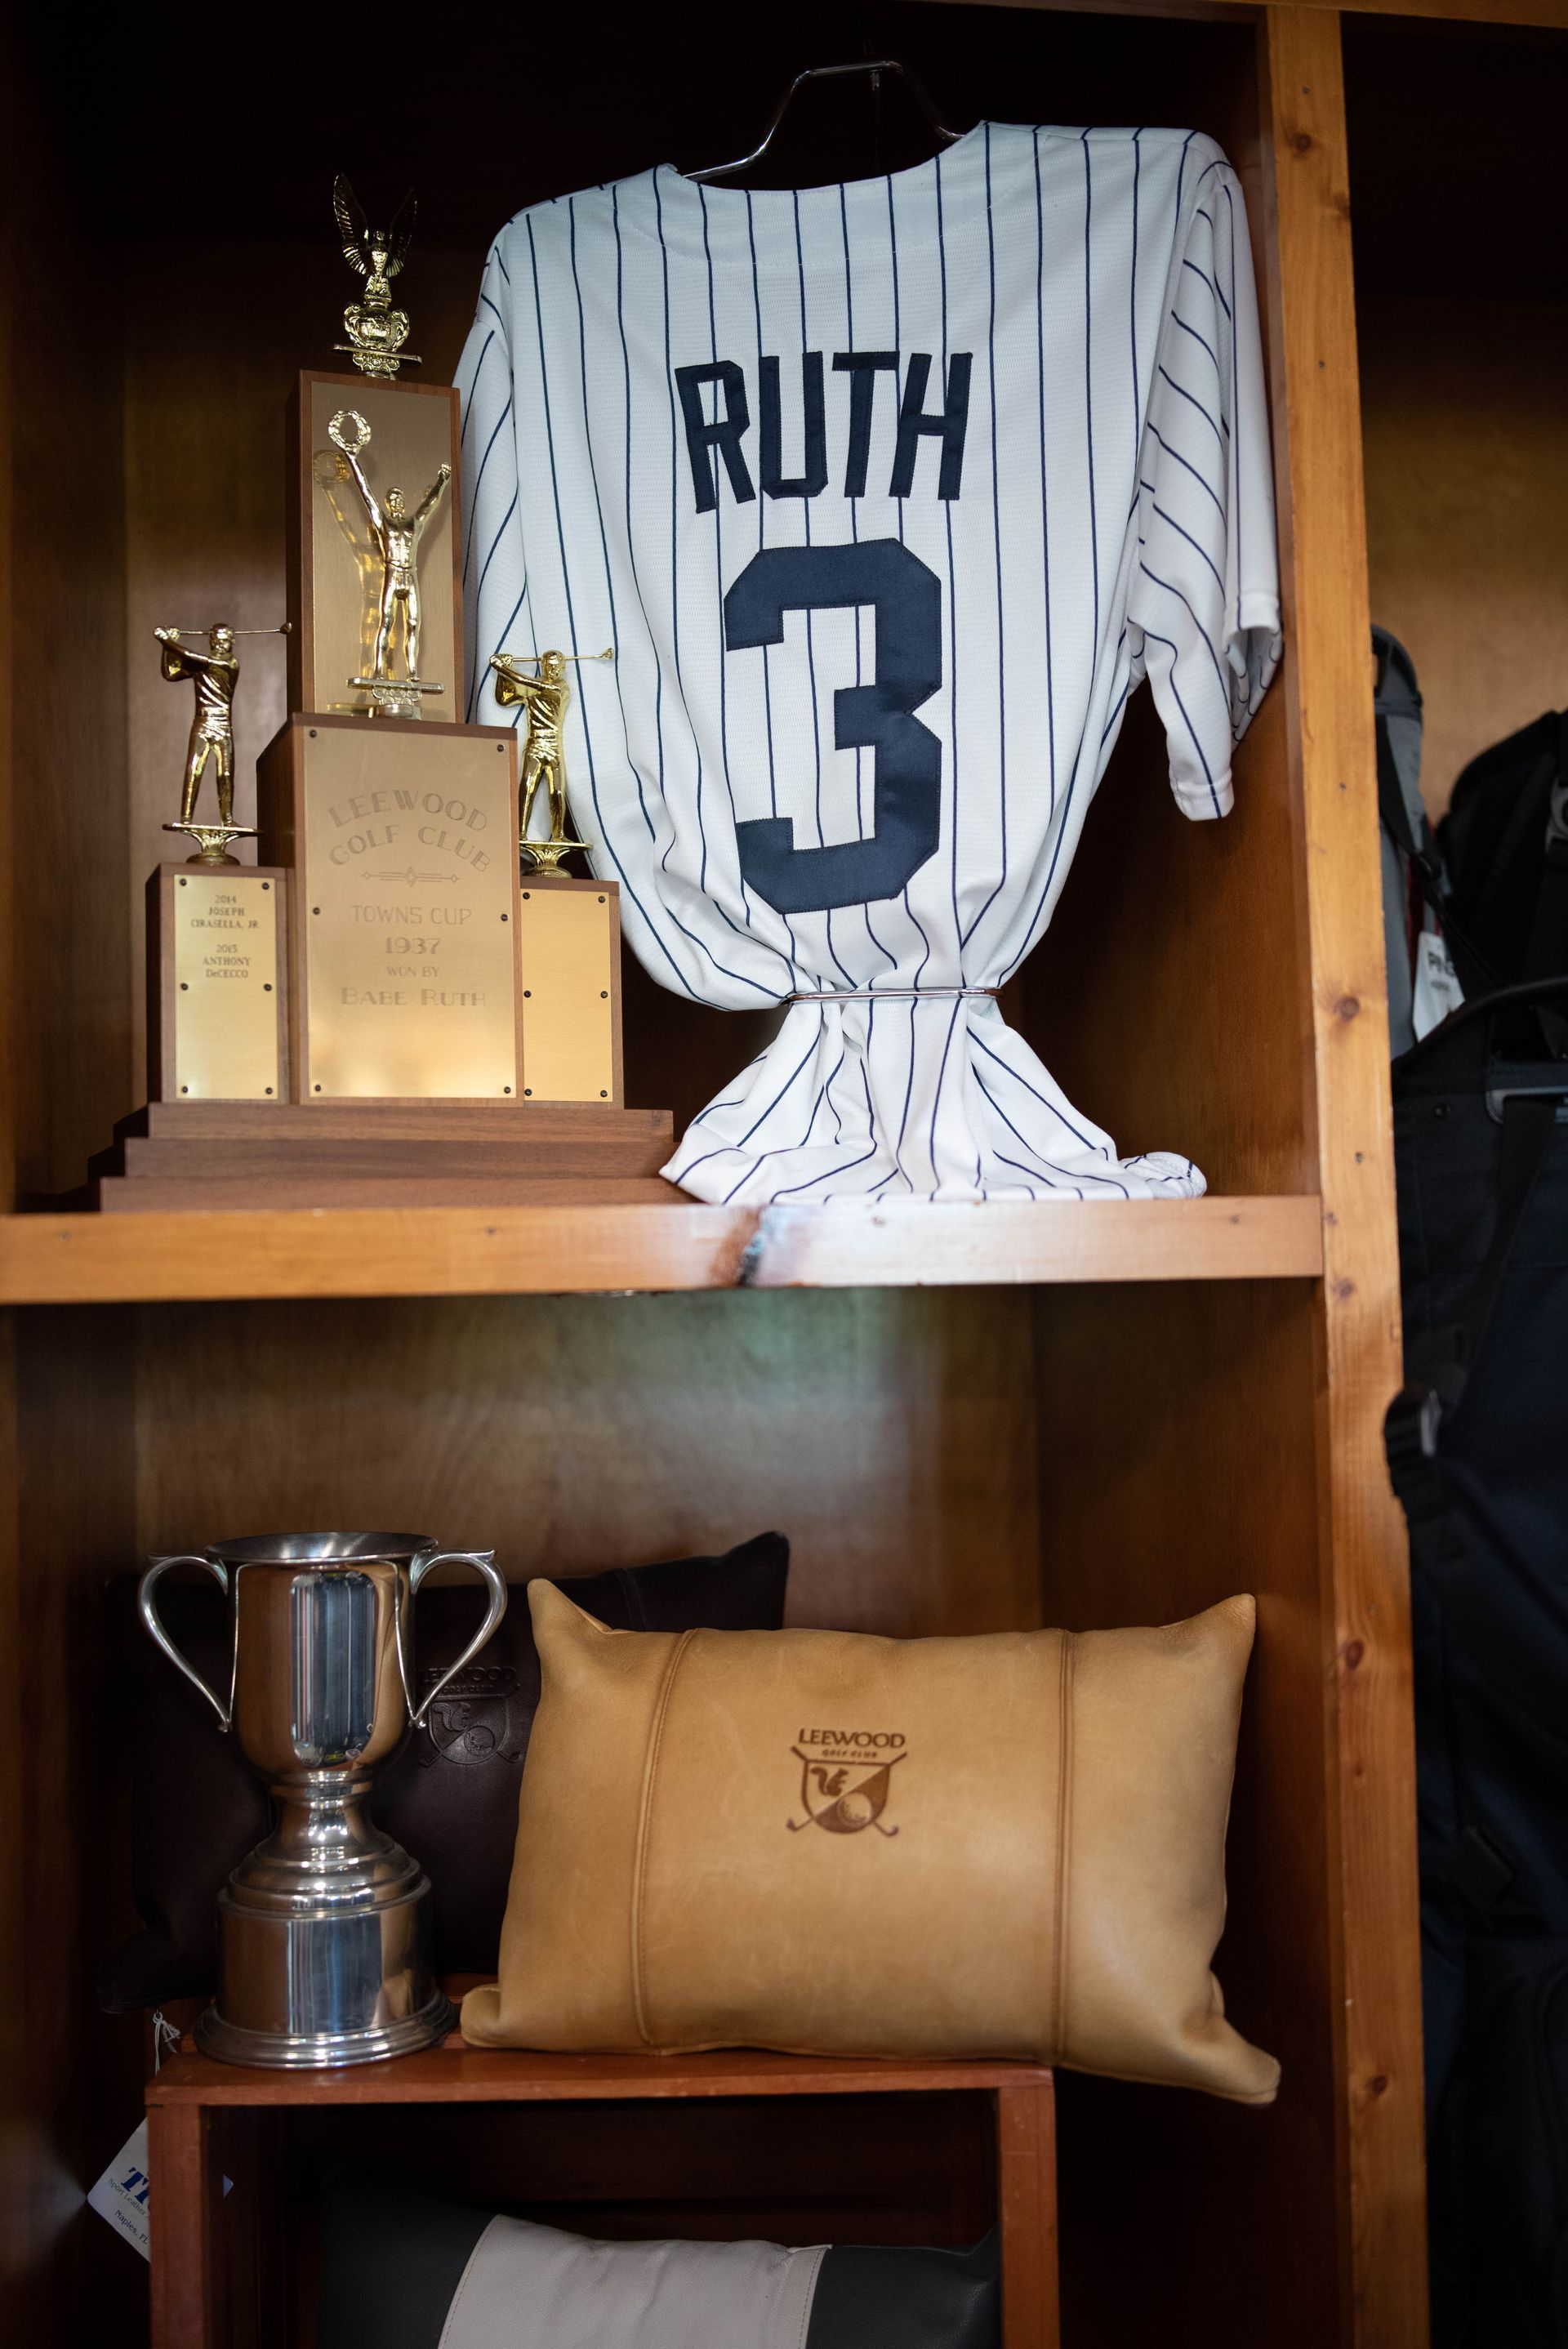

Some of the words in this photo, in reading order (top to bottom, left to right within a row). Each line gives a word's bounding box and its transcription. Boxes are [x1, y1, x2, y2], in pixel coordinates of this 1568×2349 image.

[674, 350, 973, 515] RUTH
[724, 537, 942, 915] 3
[328, 790, 488, 831] LEEWOOD
[329, 824, 400, 866] GOLF
[417, 827, 490, 871] CLUB
[214, 894, 237, 904] 2014
[207, 907, 245, 916] JOSEPH
[351, 905, 422, 925] TOWNS
[430, 907, 472, 925] CUP
[216, 944, 238, 954] 2015
[385, 937, 442, 955] 1937
[202, 956, 252, 966] ANTHONY
[386, 965, 417, 977] WON
[422, 965, 440, 978] BY
[340, 987, 407, 1006] BABE
[421, 988, 487, 1006] RUTH
[798, 1728, 906, 1749] LEEWOOD
[822, 1749, 849, 1757] GOLF
[850, 1749, 878, 1758] CLUB
[108, 2178, 125, 2196] Sport
[124, 2193, 146, 2216] Leather
[114, 2209, 138, 2236] Naples,
